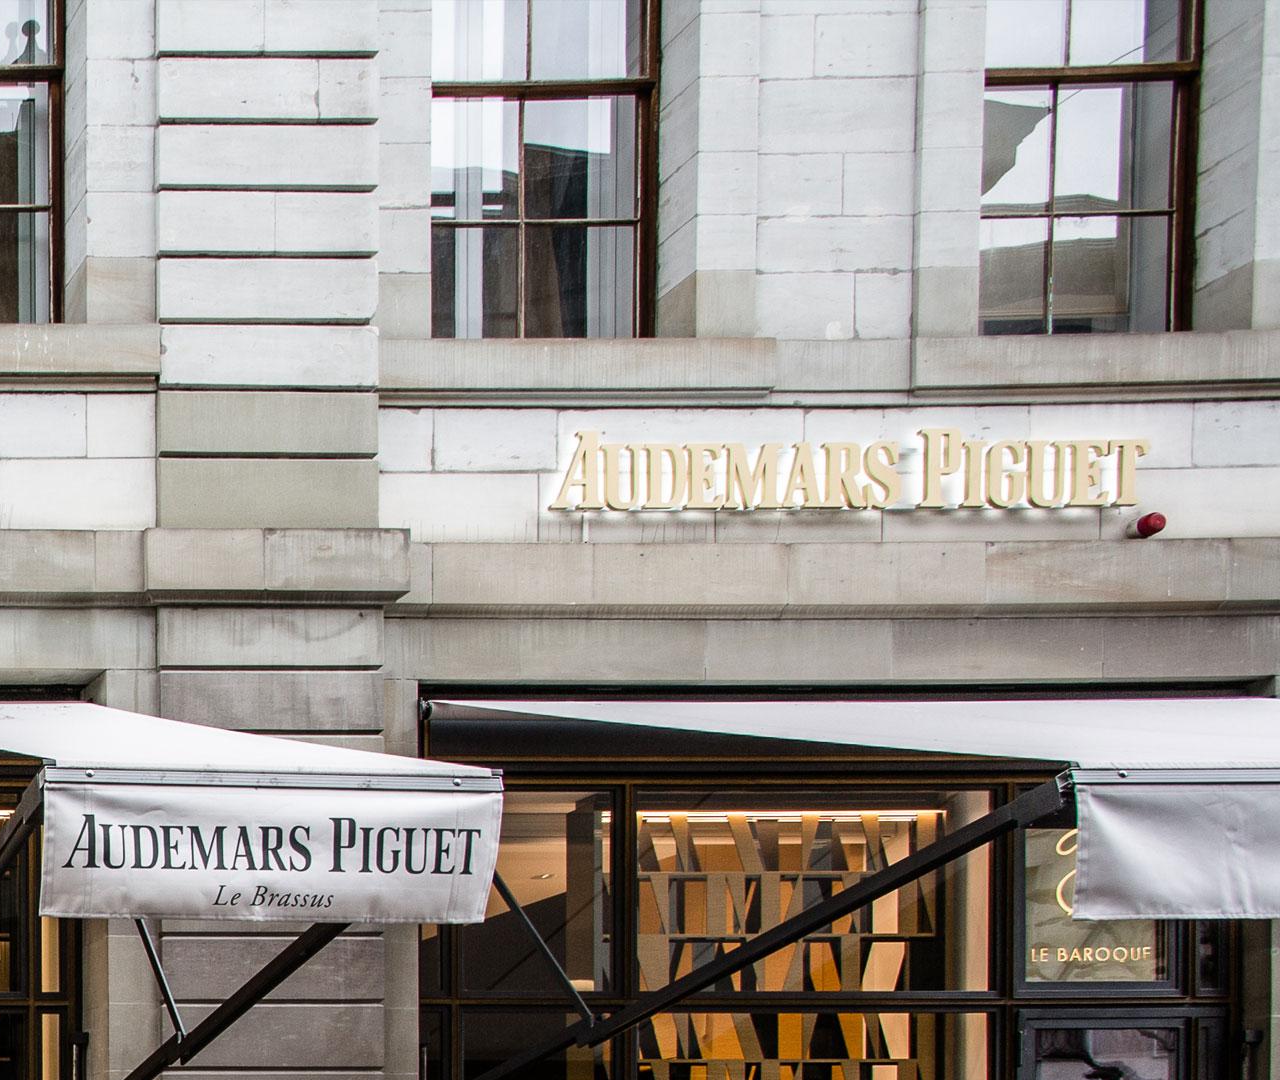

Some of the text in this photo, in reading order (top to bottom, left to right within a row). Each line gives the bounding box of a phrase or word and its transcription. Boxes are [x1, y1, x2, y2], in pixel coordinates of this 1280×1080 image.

[547, 427, 1151, 511] AUDEMARS PIGUET
[61, 813, 482, 876] AUDEMARS PIGUET
[213, 884, 335, 909] Le Brassus
[1031, 947, 1049, 963] LE
